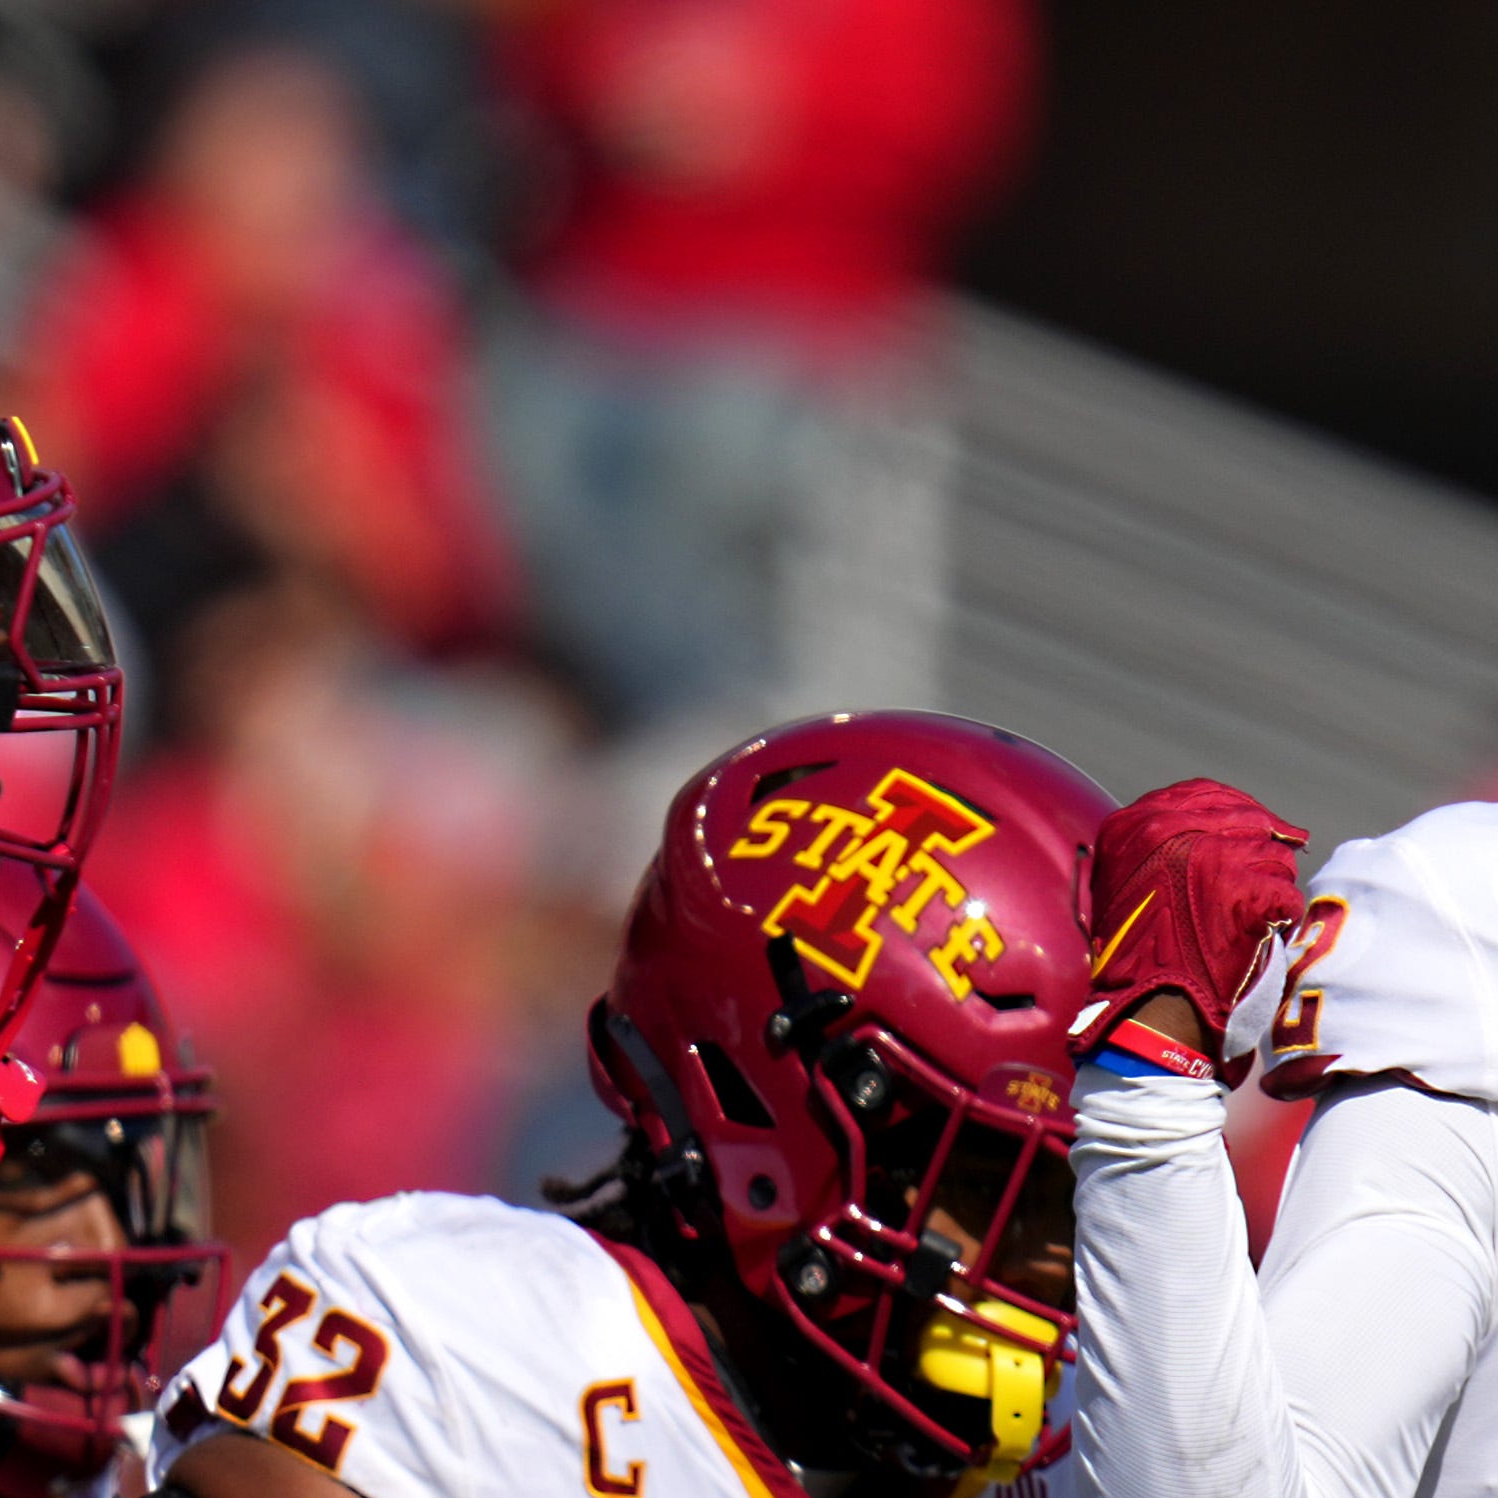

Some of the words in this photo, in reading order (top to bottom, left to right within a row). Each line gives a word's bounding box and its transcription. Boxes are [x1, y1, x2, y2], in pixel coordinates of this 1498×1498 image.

[728, 799, 1004, 1002] STATE
[1271, 895, 1351, 1054] 2
[217, 1269, 390, 1478] 32
